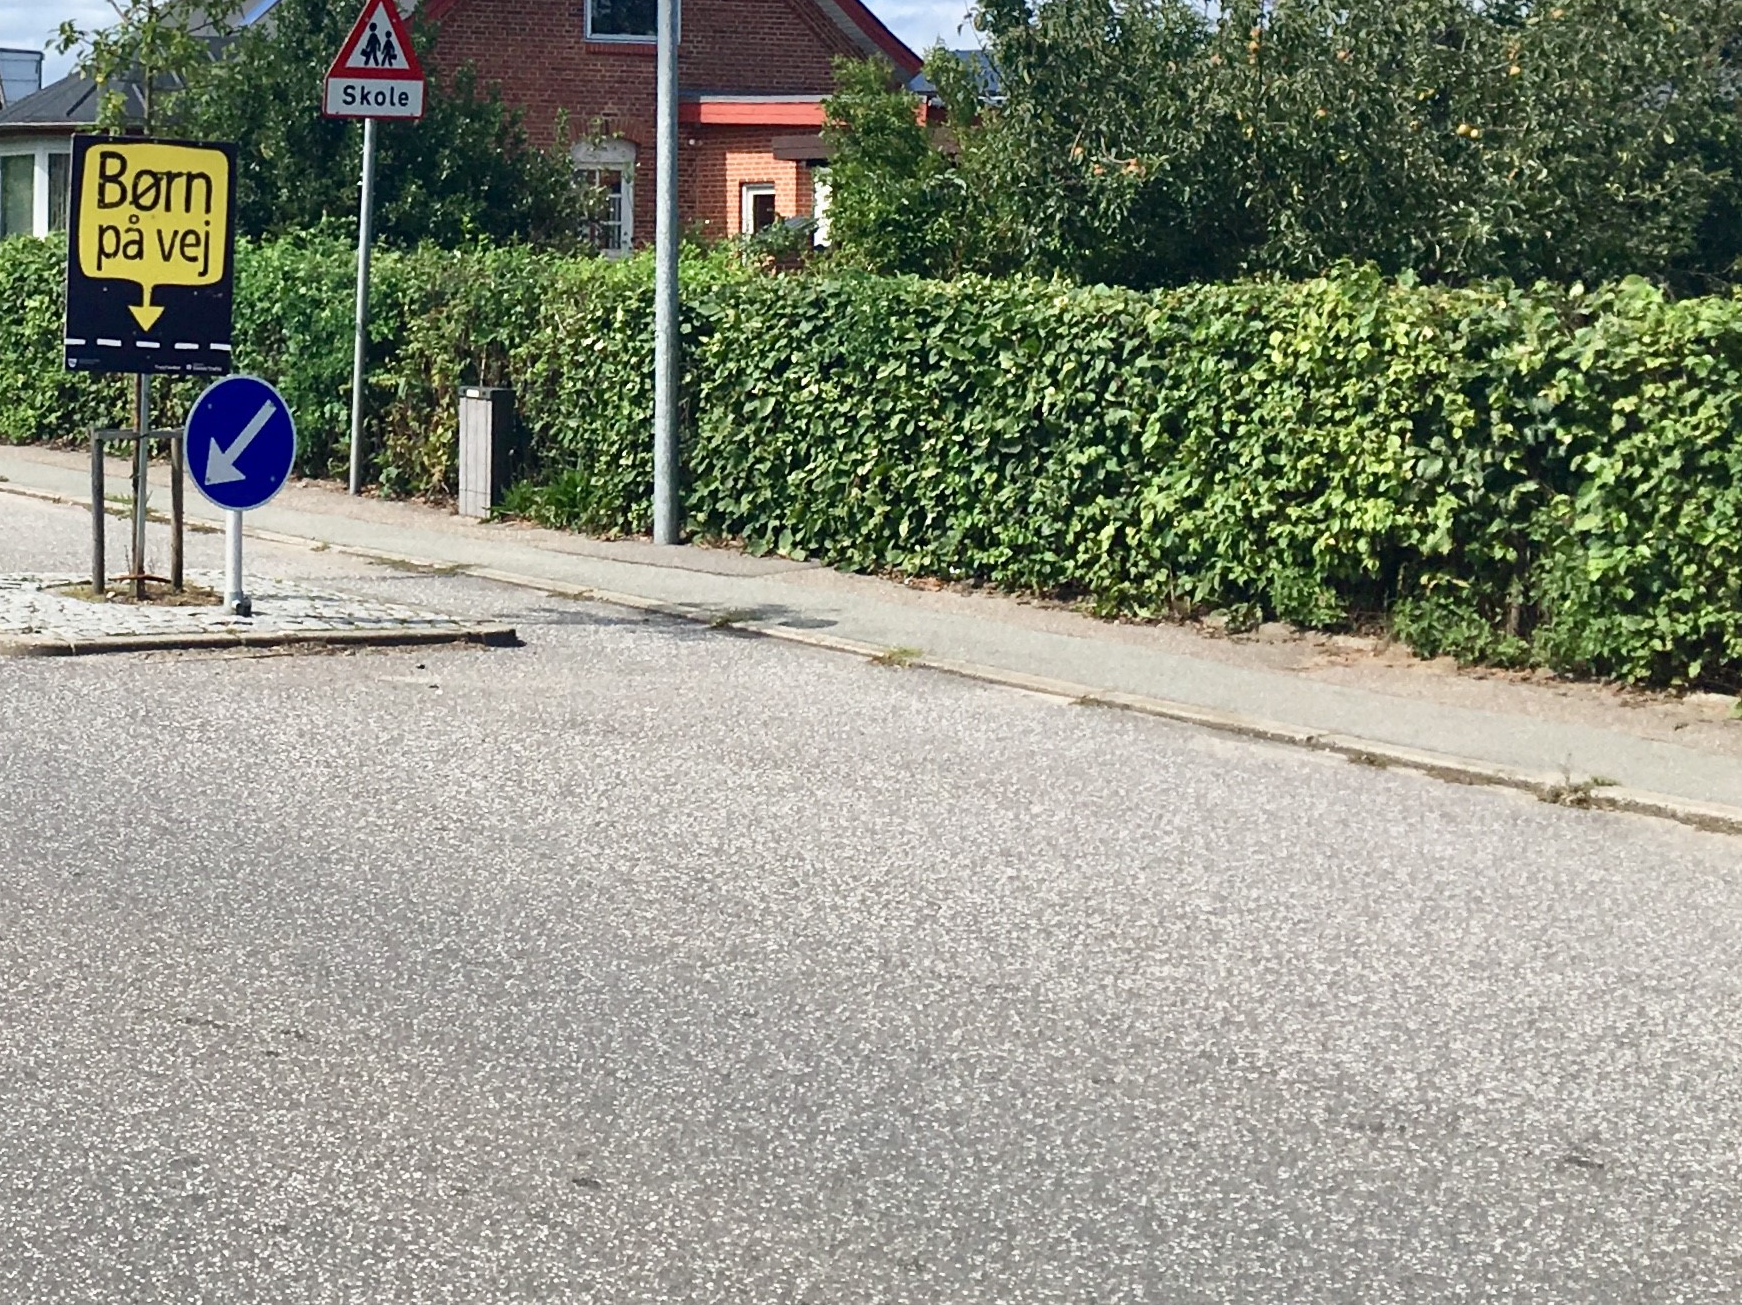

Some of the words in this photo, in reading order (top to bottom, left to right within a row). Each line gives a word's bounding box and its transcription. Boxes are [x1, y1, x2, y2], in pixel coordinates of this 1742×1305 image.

[342, 84, 409, 107] Skole
[97, 150, 213, 214] Børn
[96, 214, 144, 271] på
[156, 220, 210, 277] vej
